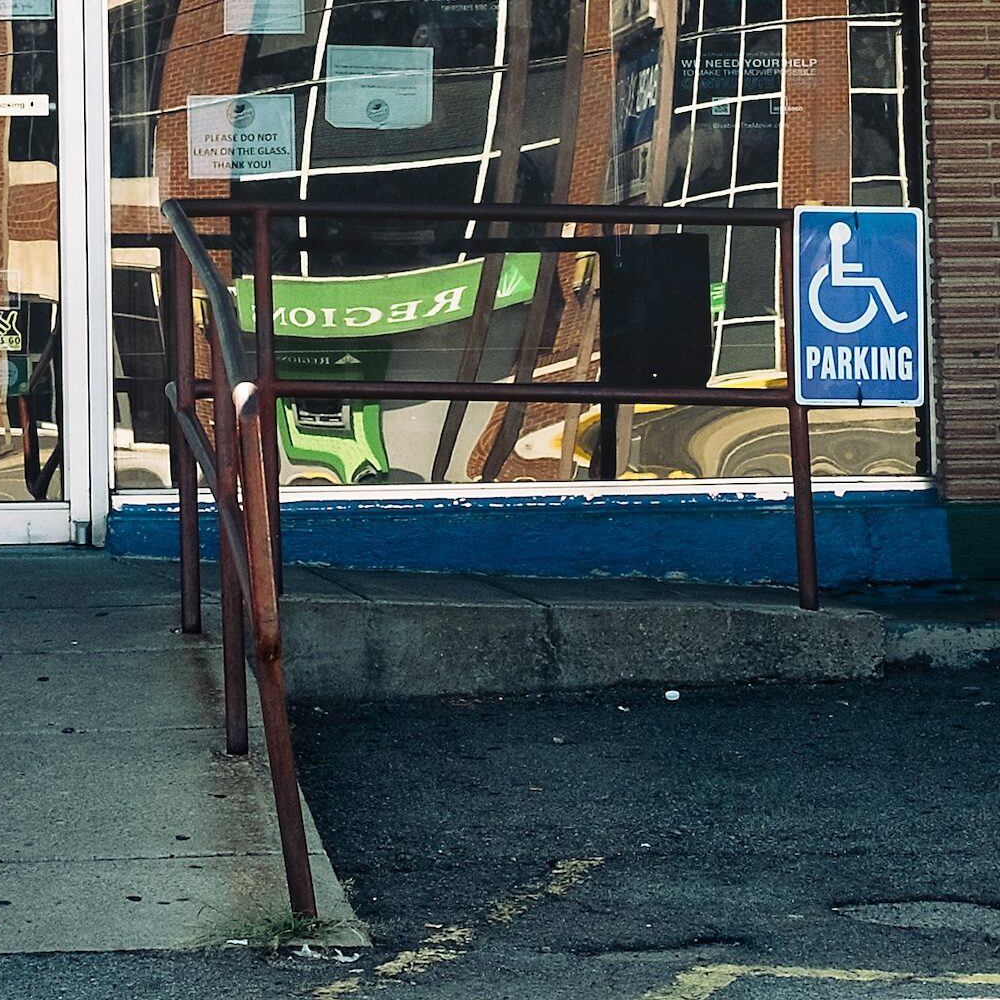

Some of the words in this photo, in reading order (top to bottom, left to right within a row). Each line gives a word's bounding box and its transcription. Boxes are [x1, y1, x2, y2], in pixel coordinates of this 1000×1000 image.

[705, 59, 740, 68] NEED
[744, 59, 780, 67] YOUR
[774, 68, 817, 76] PSSIBLE
[204, 133, 238, 142] PLEASE
[240, 133, 255, 142] DO
[257, 133, 278, 142] NOT
[193, 147, 218, 156] LEAN
[220, 147, 235, 156] ON
[237, 147, 255, 156] THE
[257, 147, 290, 156] GLASS.
[212, 160, 245, 169] THANK
[247, 160, 272, 169] YOU!
[8, 337, 21, 345] GO
[806, 345, 913, 381] PARKING
